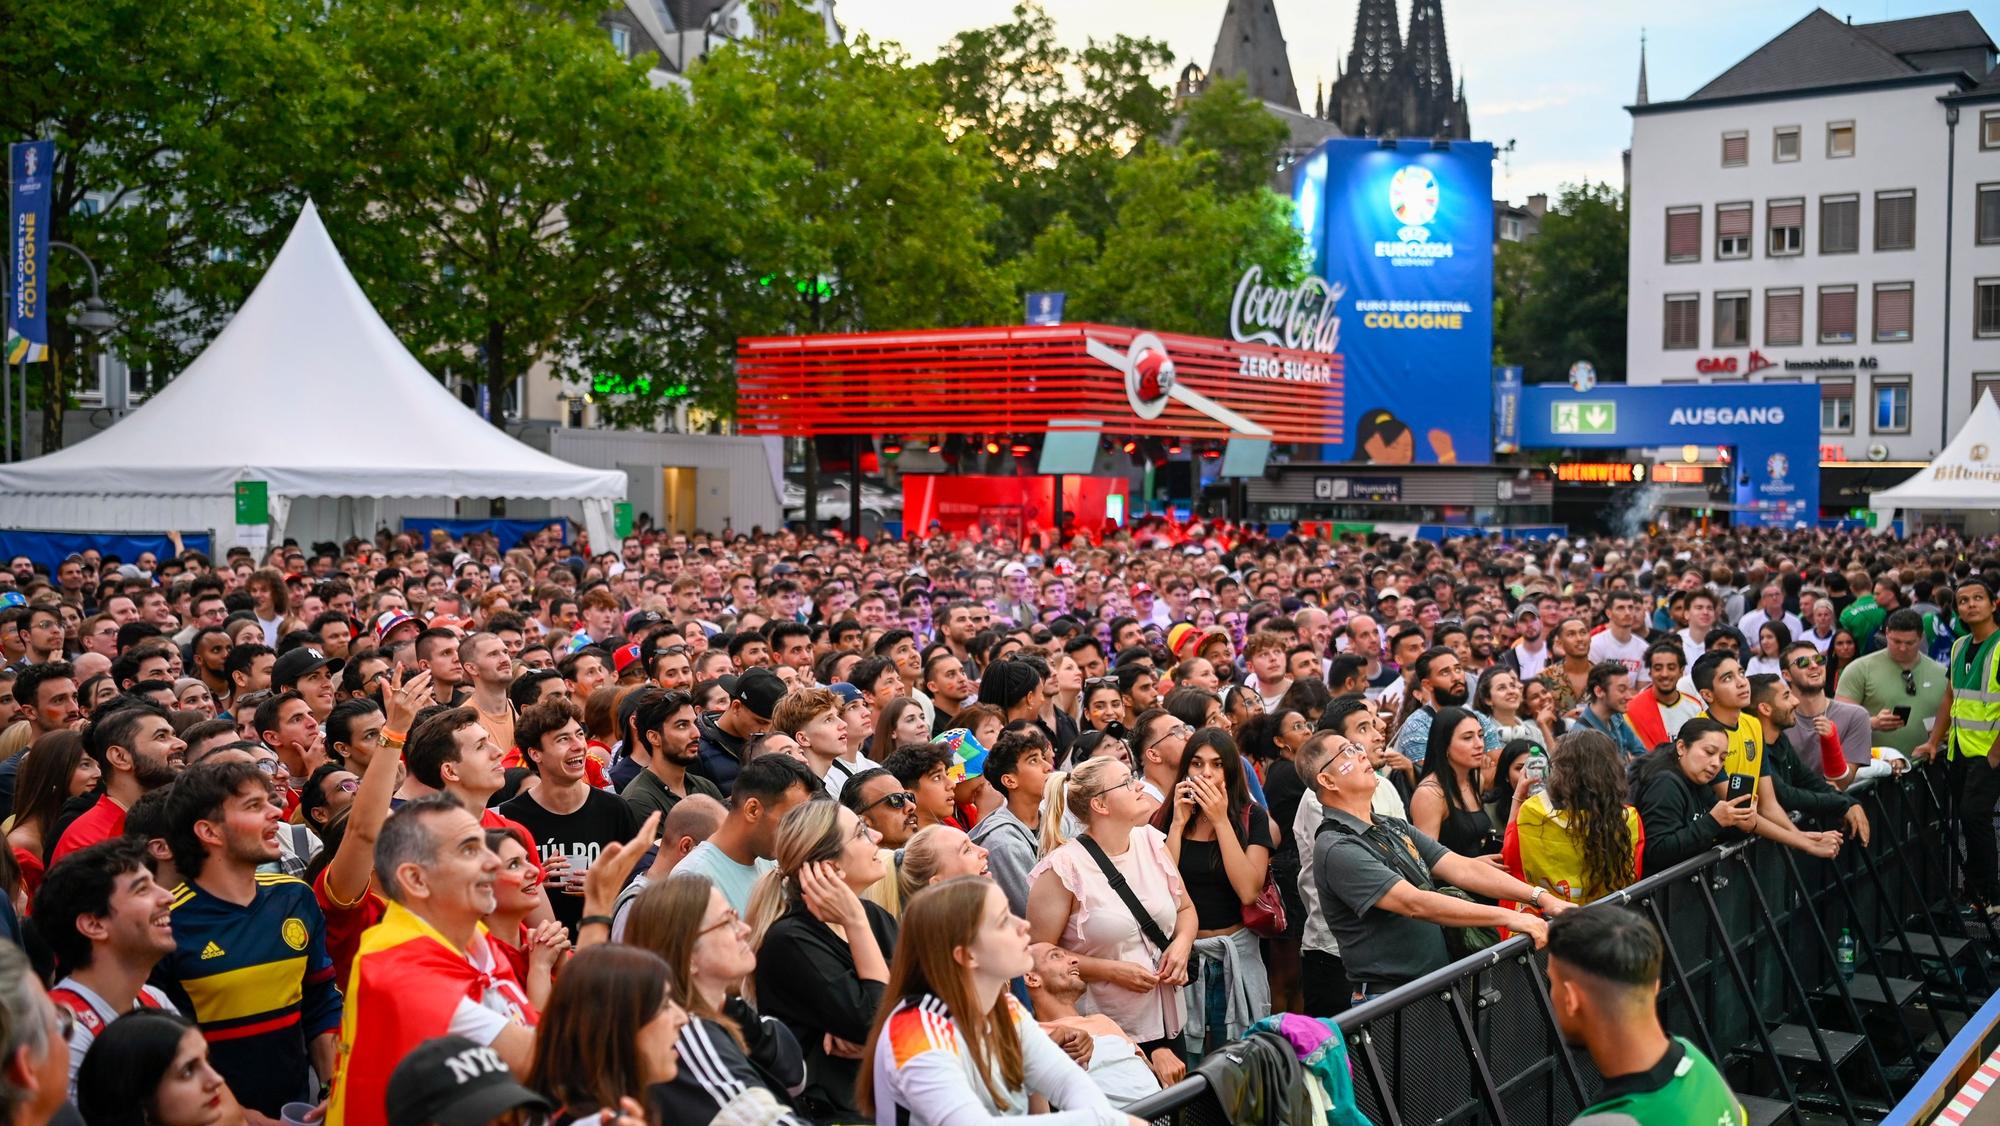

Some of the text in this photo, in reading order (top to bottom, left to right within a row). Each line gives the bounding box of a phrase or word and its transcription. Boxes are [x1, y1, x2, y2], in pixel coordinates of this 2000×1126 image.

[18, 212, 25, 234] TO
[24, 211, 37, 319] COLOGNE
[1356, 300, 1473, 313] EURO 2024 FESTIVAL
[1364, 313, 1463, 329] COLOGNE
[1239, 356, 1331, 384] ZERO SUGAR
[1696, 357, 1878, 373] GAG Immobilien AG
[1670, 407, 1785, 426] AUSGANG
[201, 949, 226, 960] adidas
